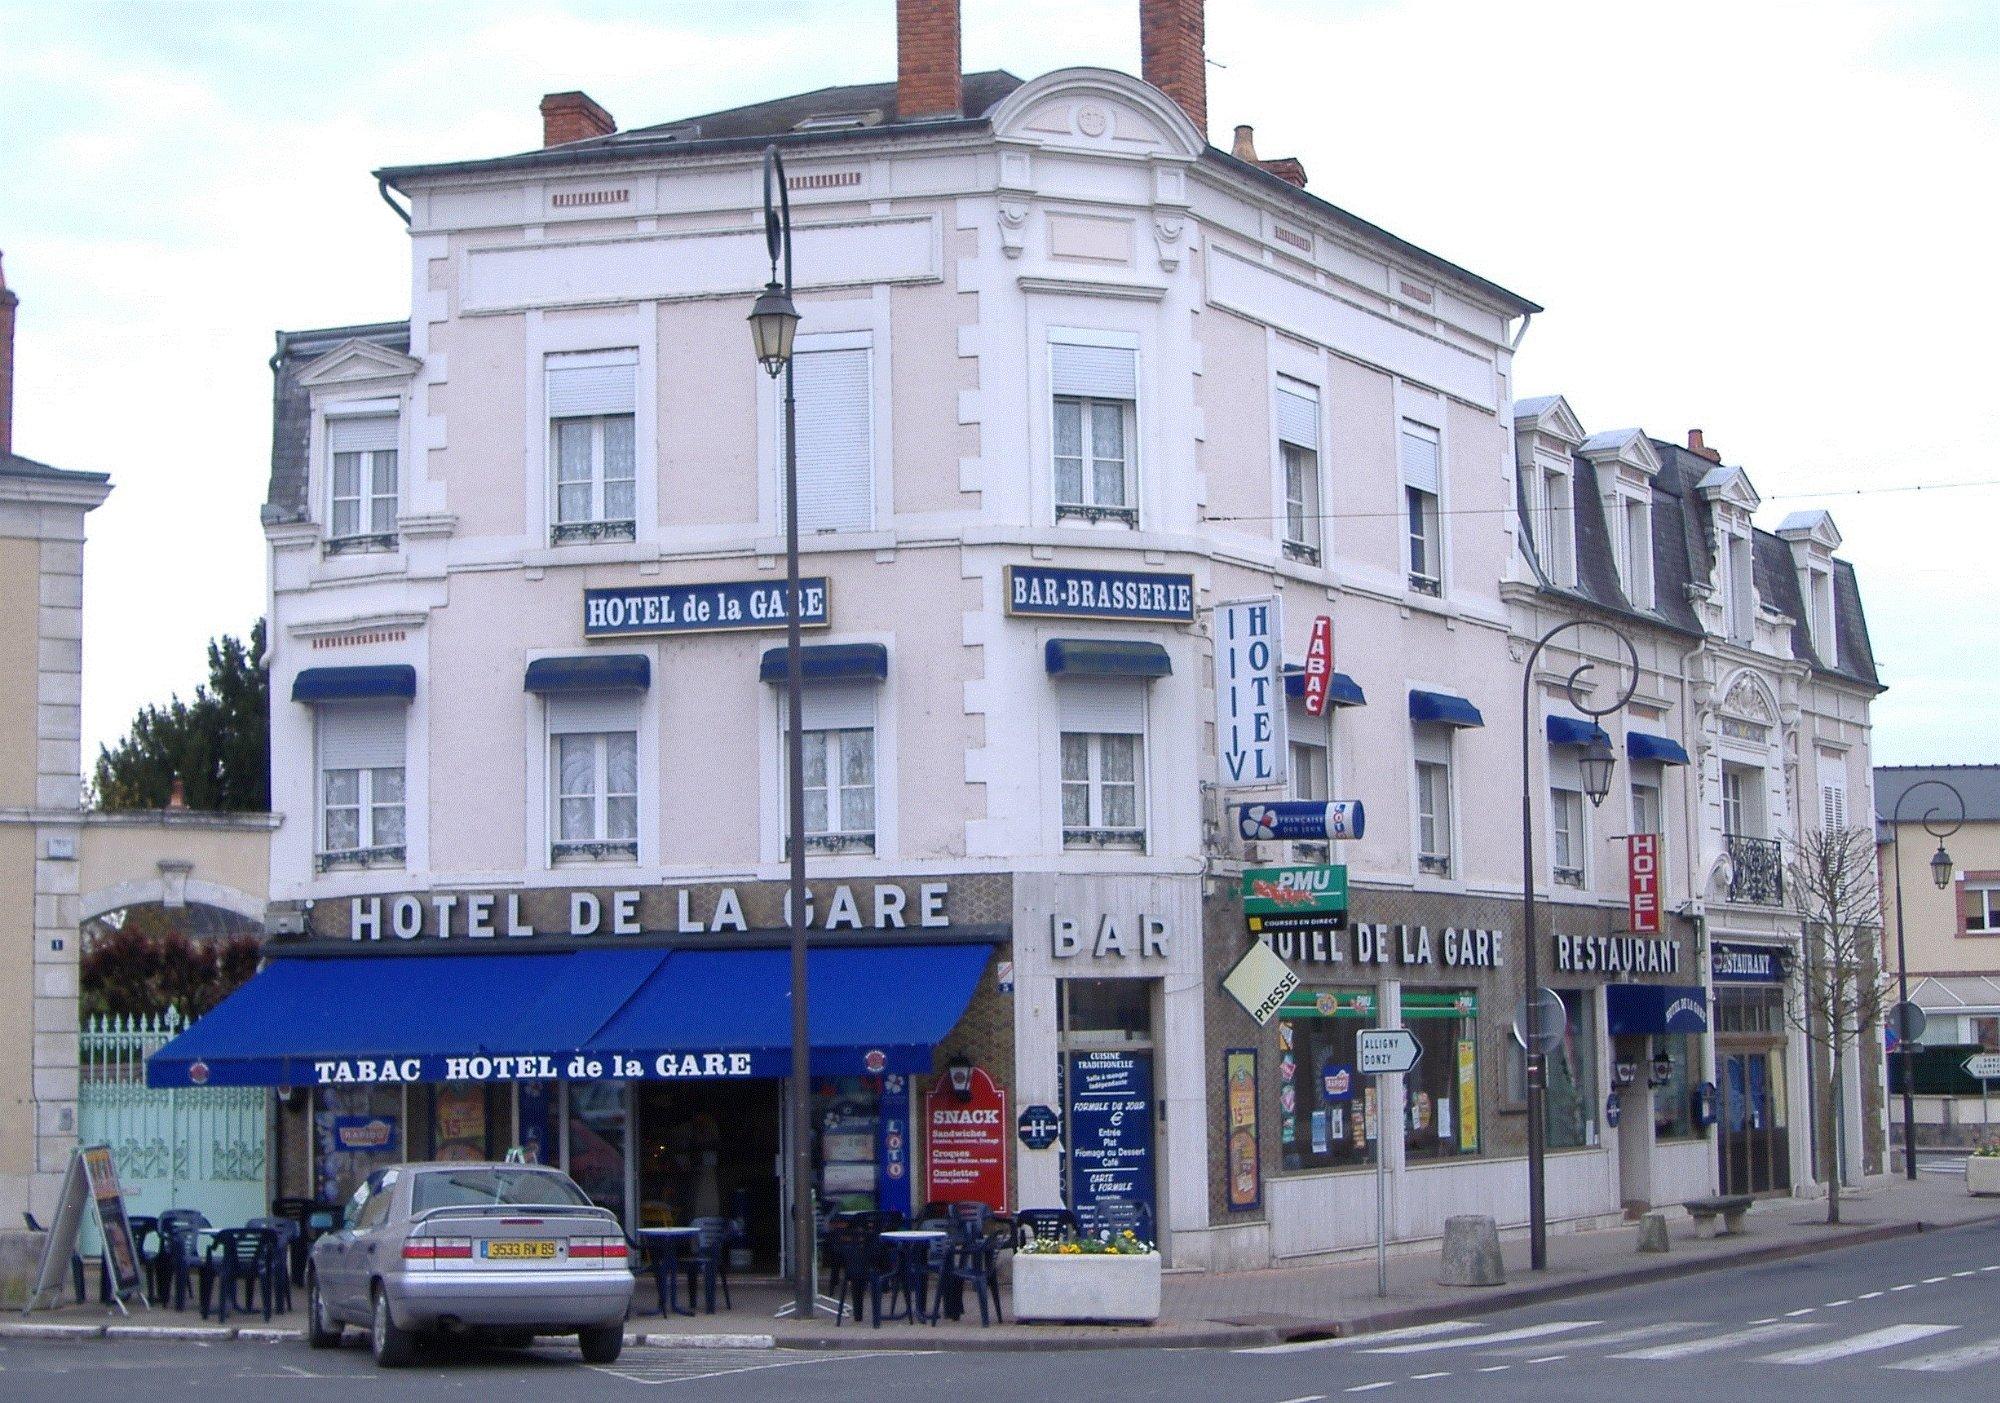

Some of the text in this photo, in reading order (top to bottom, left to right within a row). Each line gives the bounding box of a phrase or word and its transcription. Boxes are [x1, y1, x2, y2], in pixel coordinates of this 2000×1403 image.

[1014, 577, 1190, 611] BAR-BRASSERIE
[588, 596, 676, 627] HOTEL
[683, 594, 710, 622] de
[717, 592, 742, 620] la
[1306, 620, 1327, 712] TABAC
[1249, 606, 1271, 779] HOTEL
[1277, 869, 1330, 891] PMU
[1633, 836, 1654, 930] HOTEL
[351, 893, 534, 941] HOTEL
[570, 890, 641, 935] DE
[678, 888, 748, 932] LA
[1264, 917, 1338, 927] COURSES EN DIRECT
[1051, 913, 1171, 959] BAR
[1358, 923, 1389, 962] DE
[1403, 925, 1432, 964] LA
[1444, 927, 1504, 966] GARE
[1558, 934, 1681, 973] RESTAURANT
[1715, 953, 1769, 974] STAURANT
[1255, 972, 1297, 1021] PRESSE
[1365, 1039, 1398, 1049] ALLIGNY
[1090, 1052, 1120, 1060] CUISINE
[1365, 1054, 1391, 1065] DONZY
[315, 1053, 751, 1083] TABAC HOTEL de la GARE
[1078, 1060, 1134, 1069] TRADITIONELLE
[1074, 1101, 1145, 1111] FORMULE DU JOUR
[933, 1110, 999, 1123] SNACK
[1110, 1111, 1123, 1126] €
[1032, 1120, 1045, 1136] H
[1098, 1128, 1121, 1136] Entrée
[1103, 1138, 1117, 1146] Plat
[933, 1150, 970, 1159] Croques
[1075, 1149, 1105, 1158] Fromage
[1118, 1147, 1145, 1156] Dessert
[1102, 1158, 1119, 1167] Café
[1090, 1173, 1114, 1183] CARTE
[1098, 1182, 1133, 1191] FORMULE
